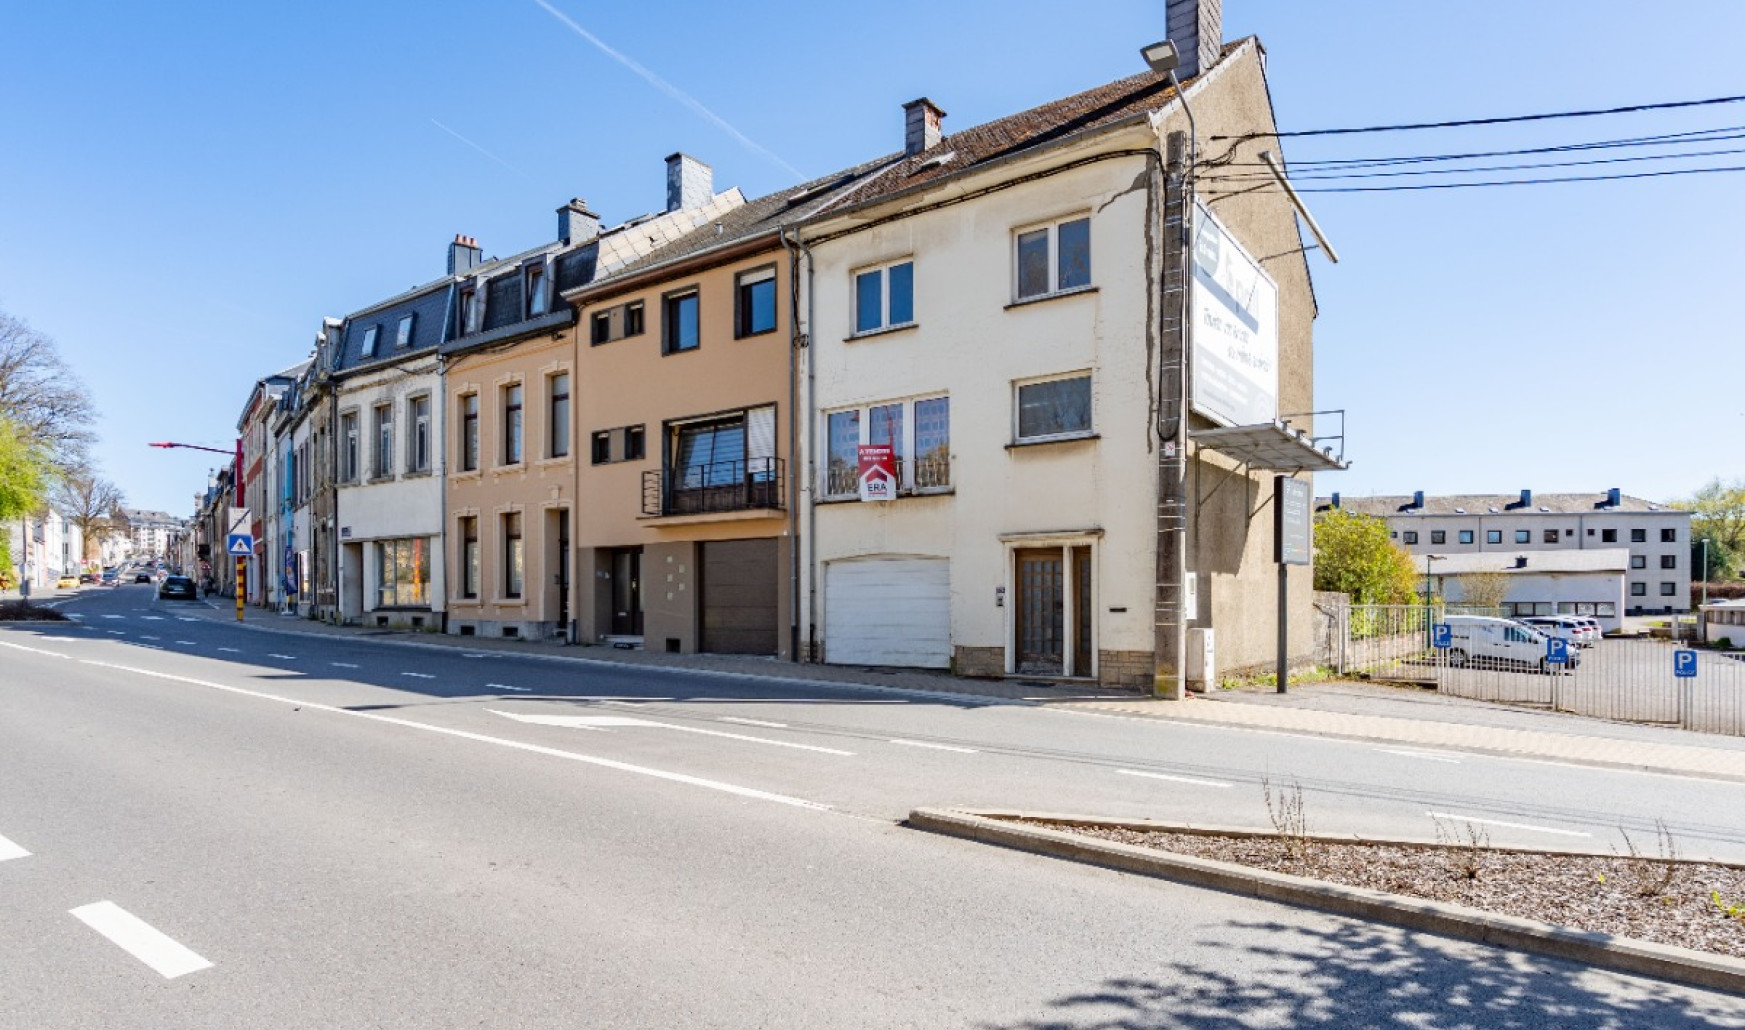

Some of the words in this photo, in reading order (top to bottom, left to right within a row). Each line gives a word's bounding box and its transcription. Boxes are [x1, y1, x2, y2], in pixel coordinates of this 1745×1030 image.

[867, 483, 887, 492] ERA
[1436, 626, 1448, 641] P
[1551, 640, 1564, 655] P
[1678, 653, 1692, 670] P
